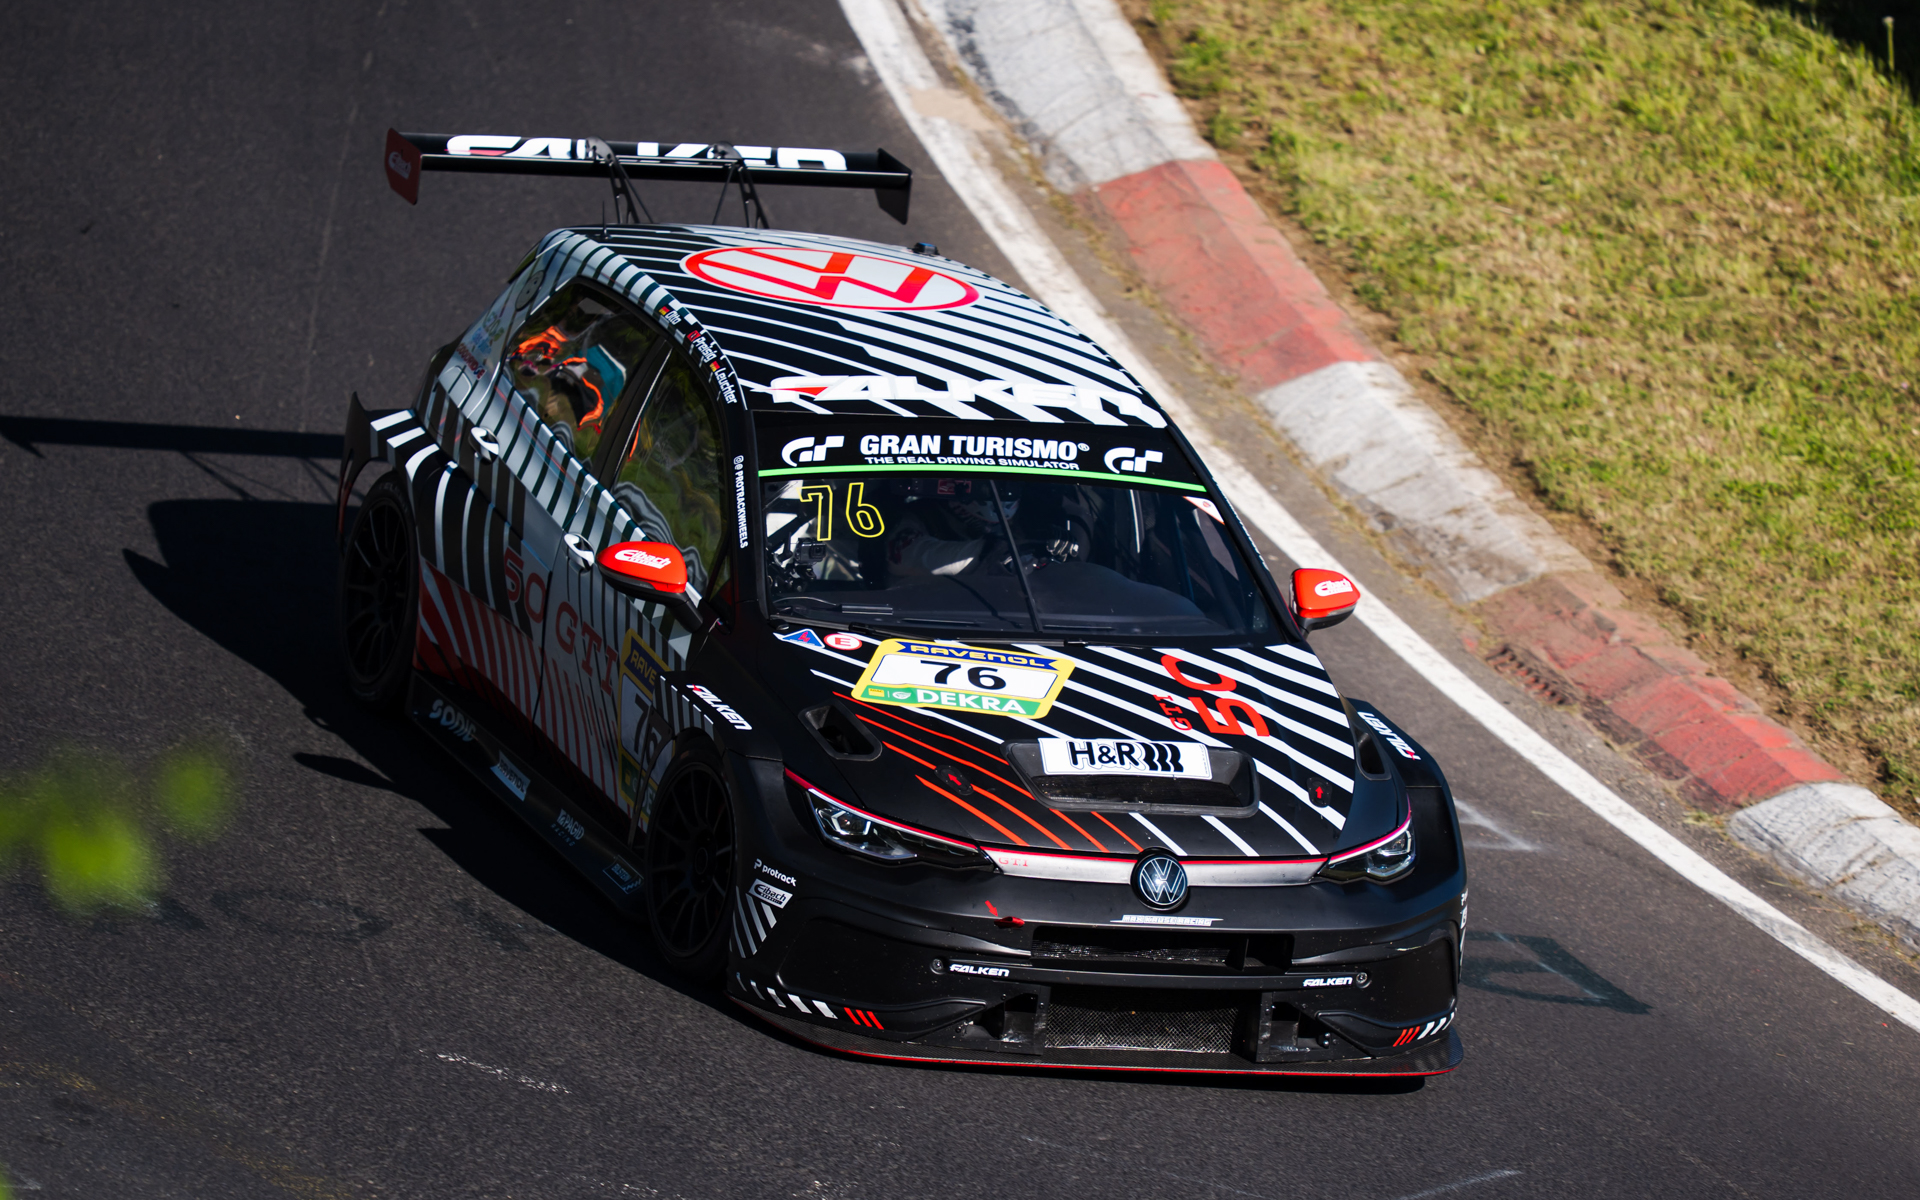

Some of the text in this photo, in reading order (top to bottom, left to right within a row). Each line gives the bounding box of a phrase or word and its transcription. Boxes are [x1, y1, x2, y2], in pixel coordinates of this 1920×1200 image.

[693, 336, 717, 363] Preisig
[714, 367, 738, 404] Leuchter
[769, 375, 1144, 416] FALKEN
[860, 435, 942, 456] GRAN
[865, 456, 1080, 471] THE REAL DRIVING SIMULATOR
[797, 482, 885, 541] 76
[504, 547, 547, 624] 50
[556, 601, 618, 696] GTI
[910, 645, 1046, 668] RAVENOL
[629, 649, 657, 684] RAVE
[919, 660, 1007, 691] 76
[686, 684, 753, 731] FALKEN
[916, 687, 1028, 715] DEKRA
[1160, 654, 1270, 737] 50
[1152, 694, 1193, 731] GTI
[1357, 711, 1421, 760] FALKEN
[1067, 740, 1141, 768] H&R
[550, 823, 576, 848] RACING
[560, 811, 585, 841] PAGID
[761, 864, 797, 887] protrack
[998, 856, 1030, 868] GTI
[754, 884, 788, 904] Eibach
[950, 964, 1010, 978] FALKEN
[1302, 976, 1353, 988] FALKEN
